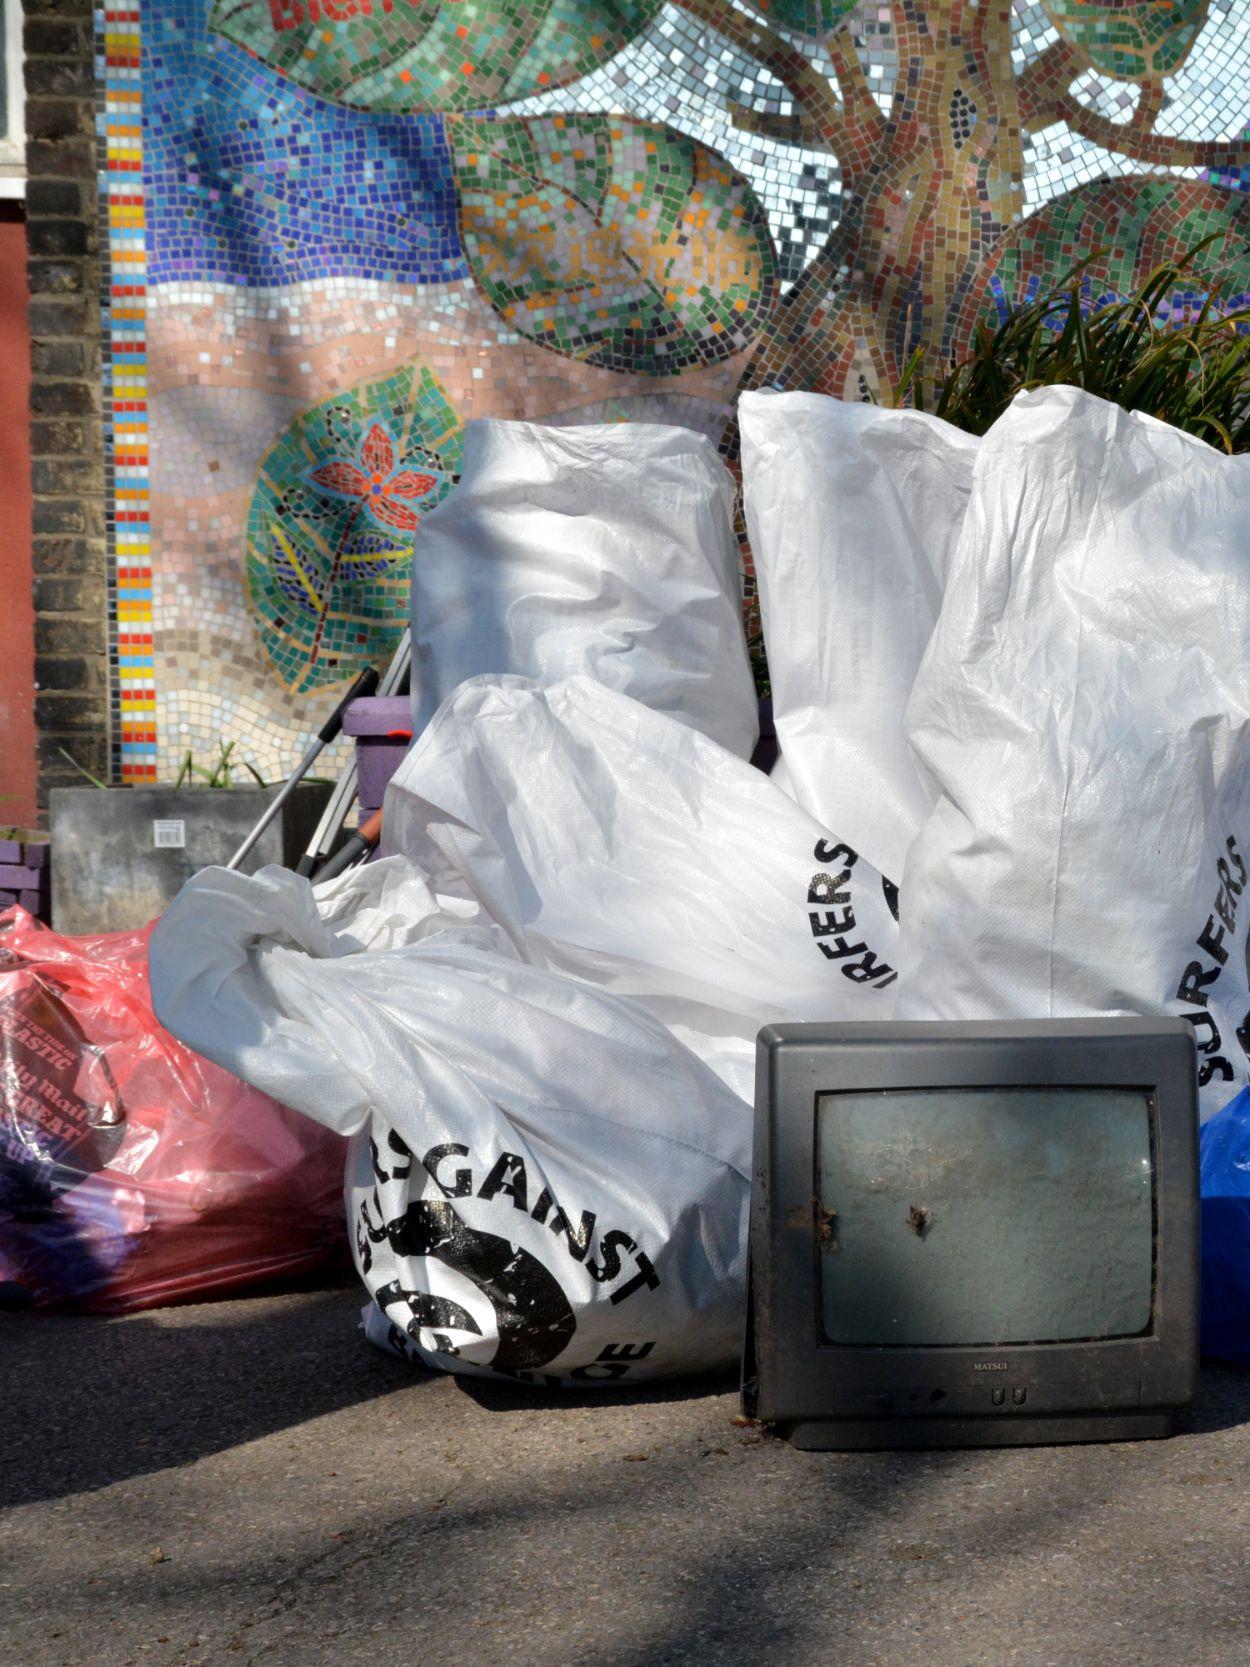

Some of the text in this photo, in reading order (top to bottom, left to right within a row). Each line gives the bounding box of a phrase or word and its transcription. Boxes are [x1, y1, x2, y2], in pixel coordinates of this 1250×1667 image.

[1176, 834, 1248, 1088] SURFERS
[37, 1077, 88, 1123] Mail
[973, 1362, 1008, 1370] MATSUI
